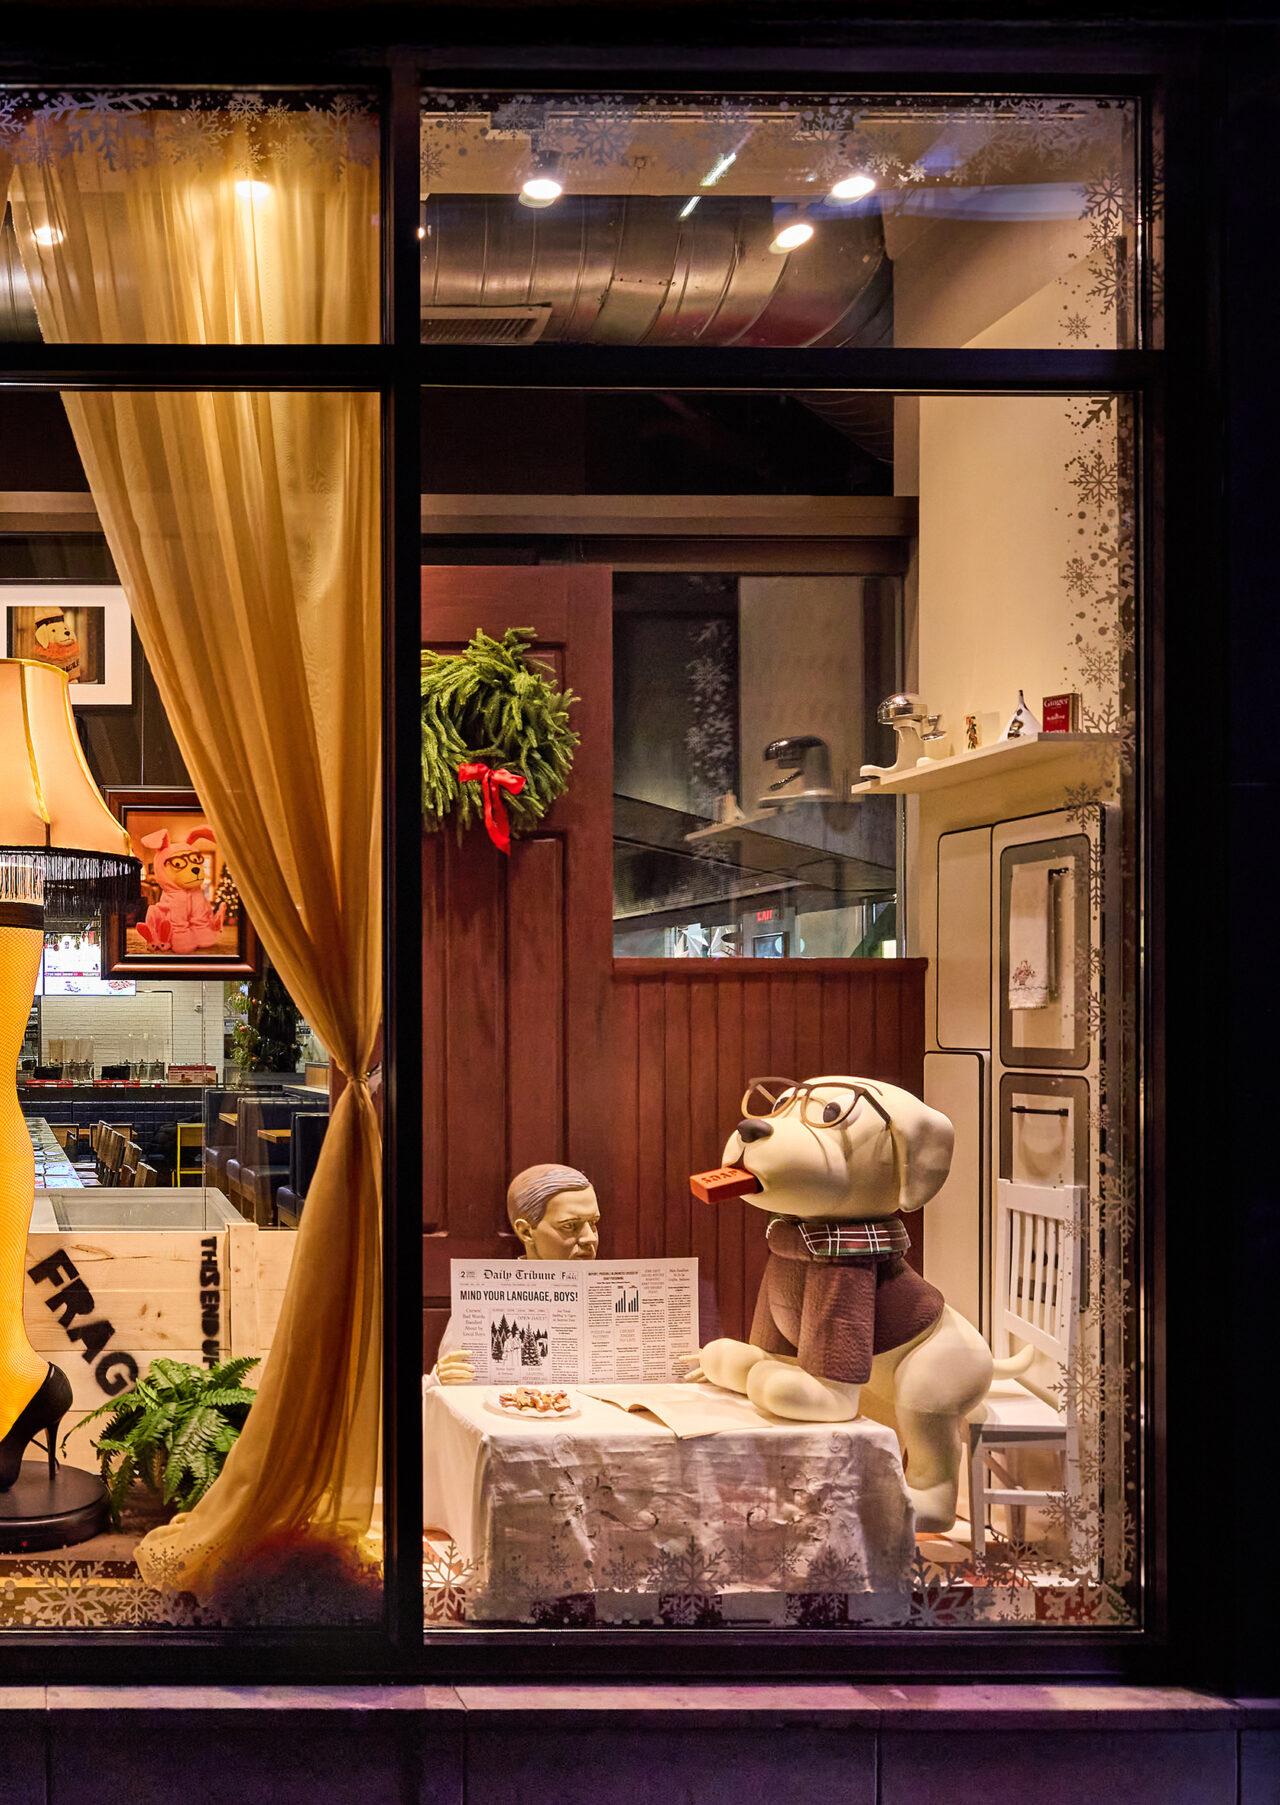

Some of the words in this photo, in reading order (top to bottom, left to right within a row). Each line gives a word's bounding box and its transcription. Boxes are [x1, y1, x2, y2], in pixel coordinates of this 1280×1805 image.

[200, 1236, 220, 1288] THIS
[483, 1269, 512, 1281] Daily
[515, 1269, 556, 1280] Tribune
[460, 1290, 482, 1301] MIND
[483, 1290, 505, 1301] YOUR
[506, 1291, 552, 1303] LANGUAGE,
[554, 1291, 578, 1302] BOYS!
[200, 1290, 220, 1338] END
